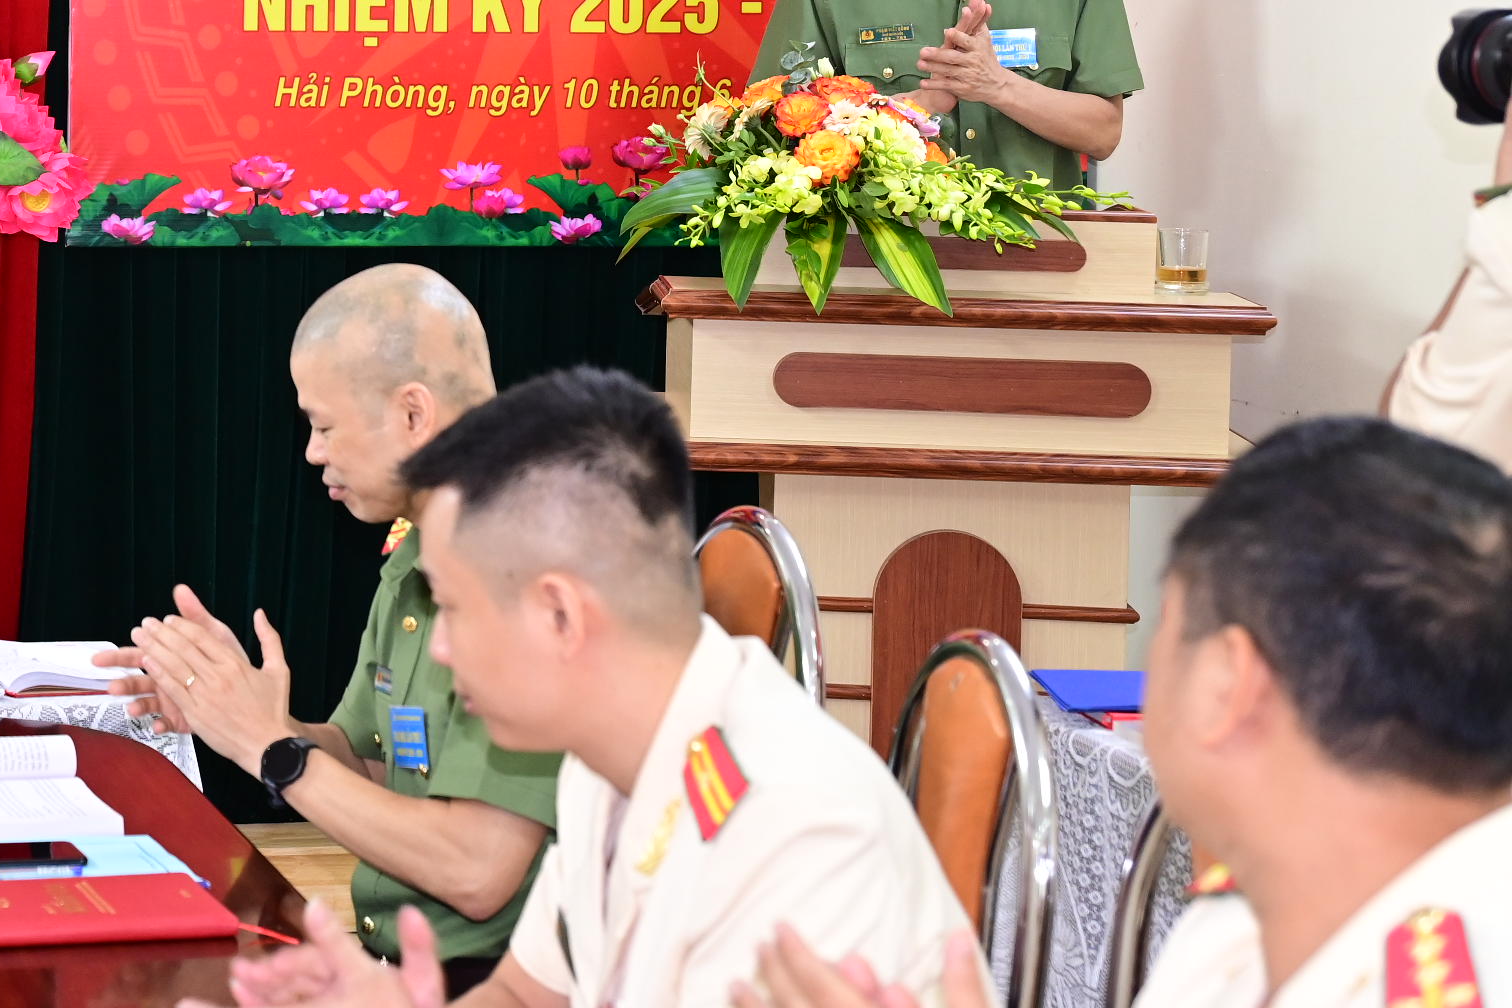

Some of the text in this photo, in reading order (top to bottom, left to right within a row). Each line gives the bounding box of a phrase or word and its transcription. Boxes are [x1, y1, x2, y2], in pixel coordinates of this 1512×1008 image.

[274, 72, 330, 108] Hải
[339, 76, 456, 117] Phòng,
[468, 76, 551, 117] ngày
[563, 78, 599, 109] 10
[609, 76, 702, 116] tháng
